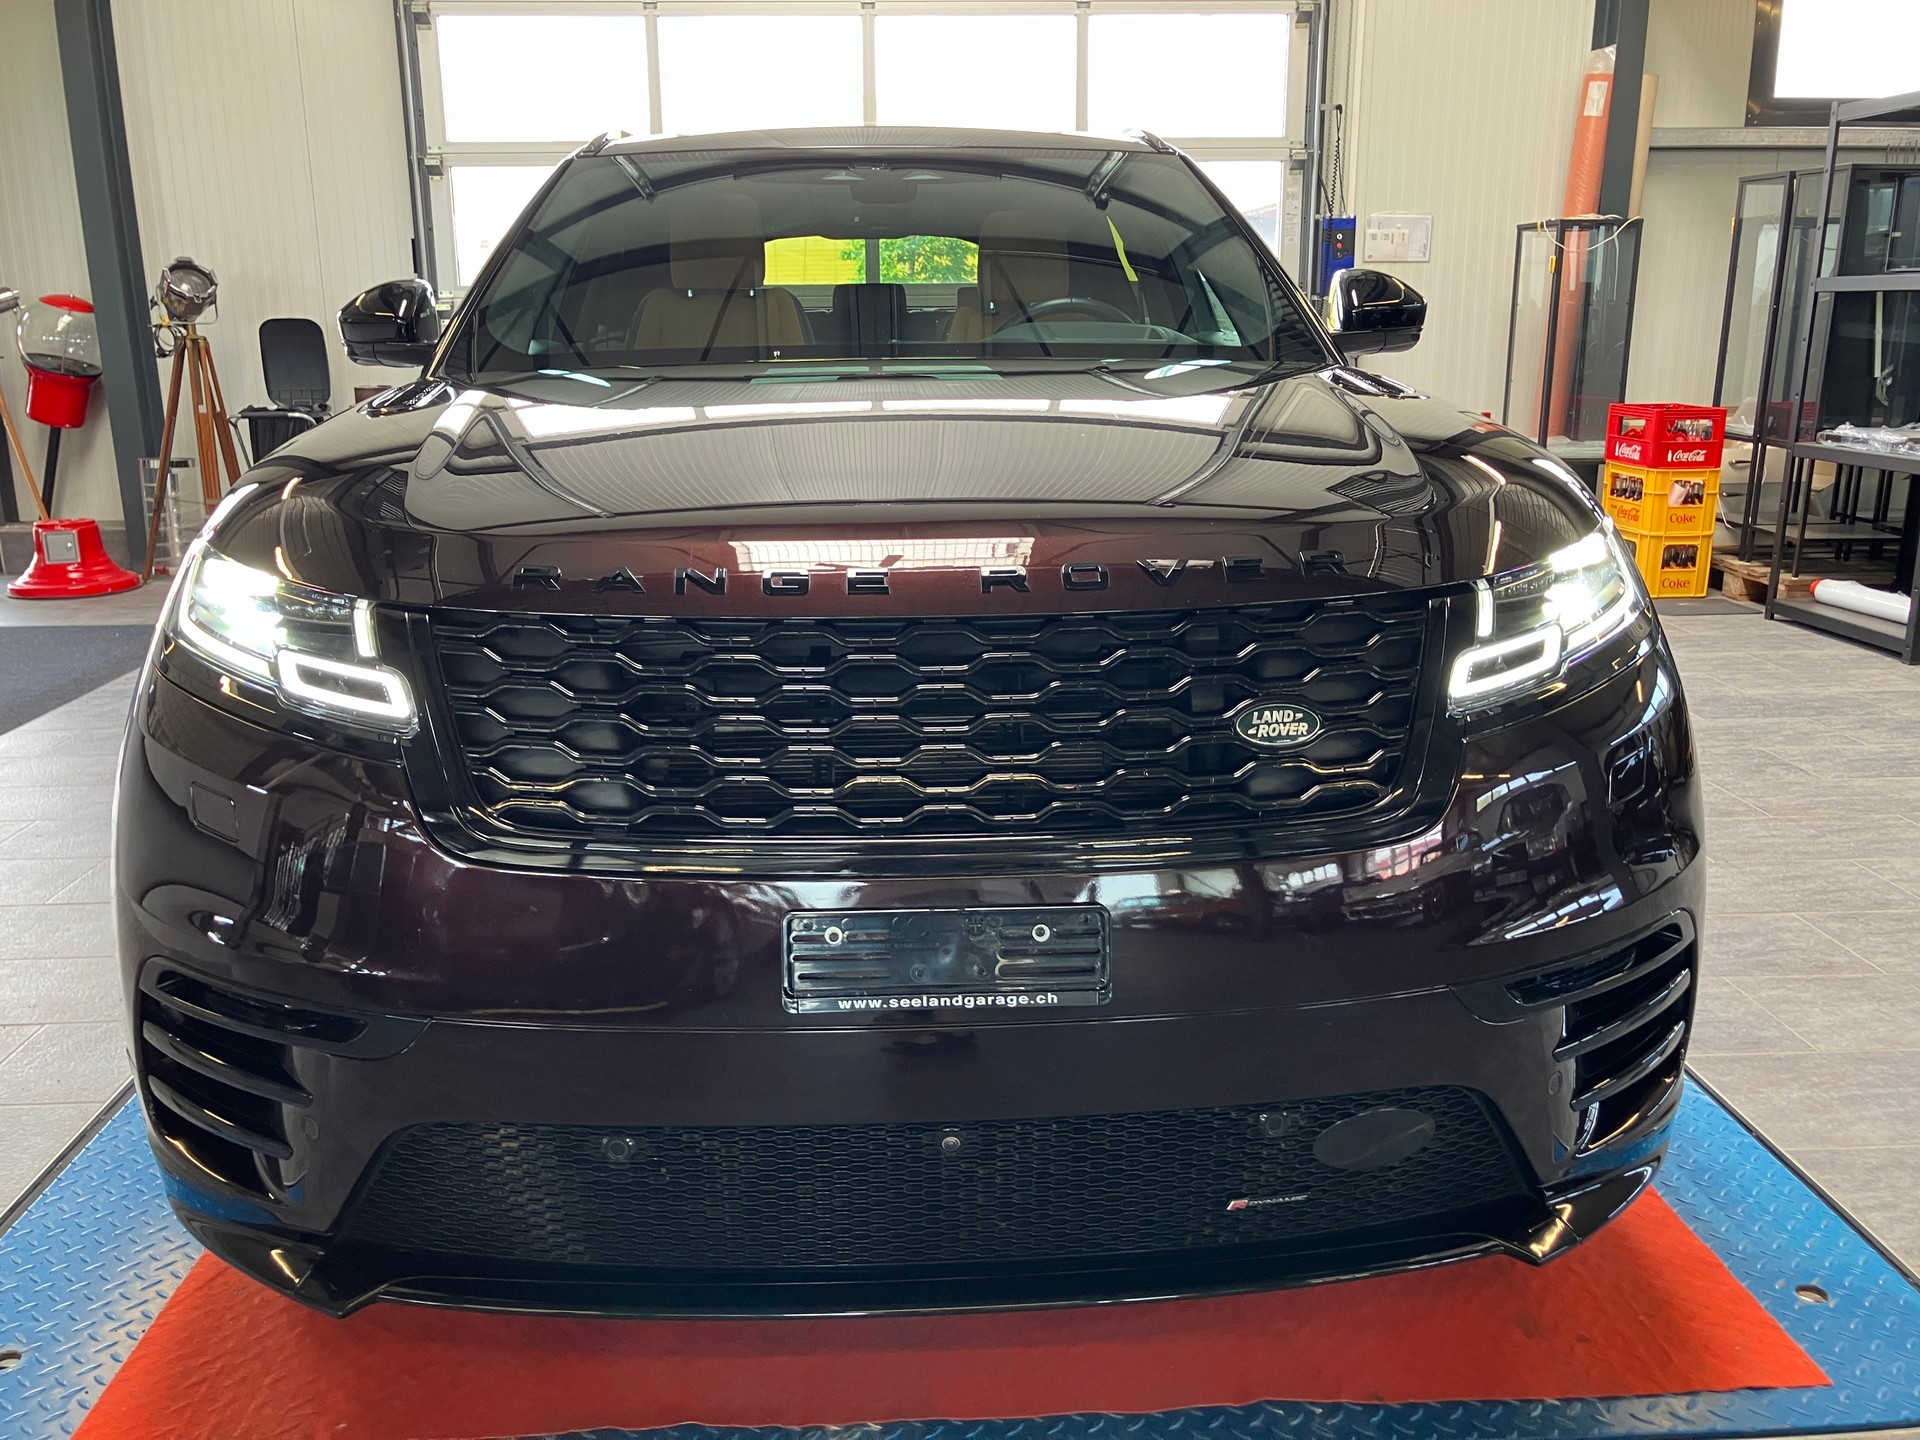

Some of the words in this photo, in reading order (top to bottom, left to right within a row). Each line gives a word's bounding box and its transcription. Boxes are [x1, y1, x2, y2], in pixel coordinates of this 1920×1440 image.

[1670, 513, 1696, 523] Coke
[513, 566, 891, 595] RANGE
[980, 550, 1351, 593] ROVER
[1662, 578, 1690, 588] Coke
[1252, 710, 1294, 724] LAND
[1257, 722, 1308, 737] ROVER
[838, 993, 1058, 1009] www.seelandgarage.ch
